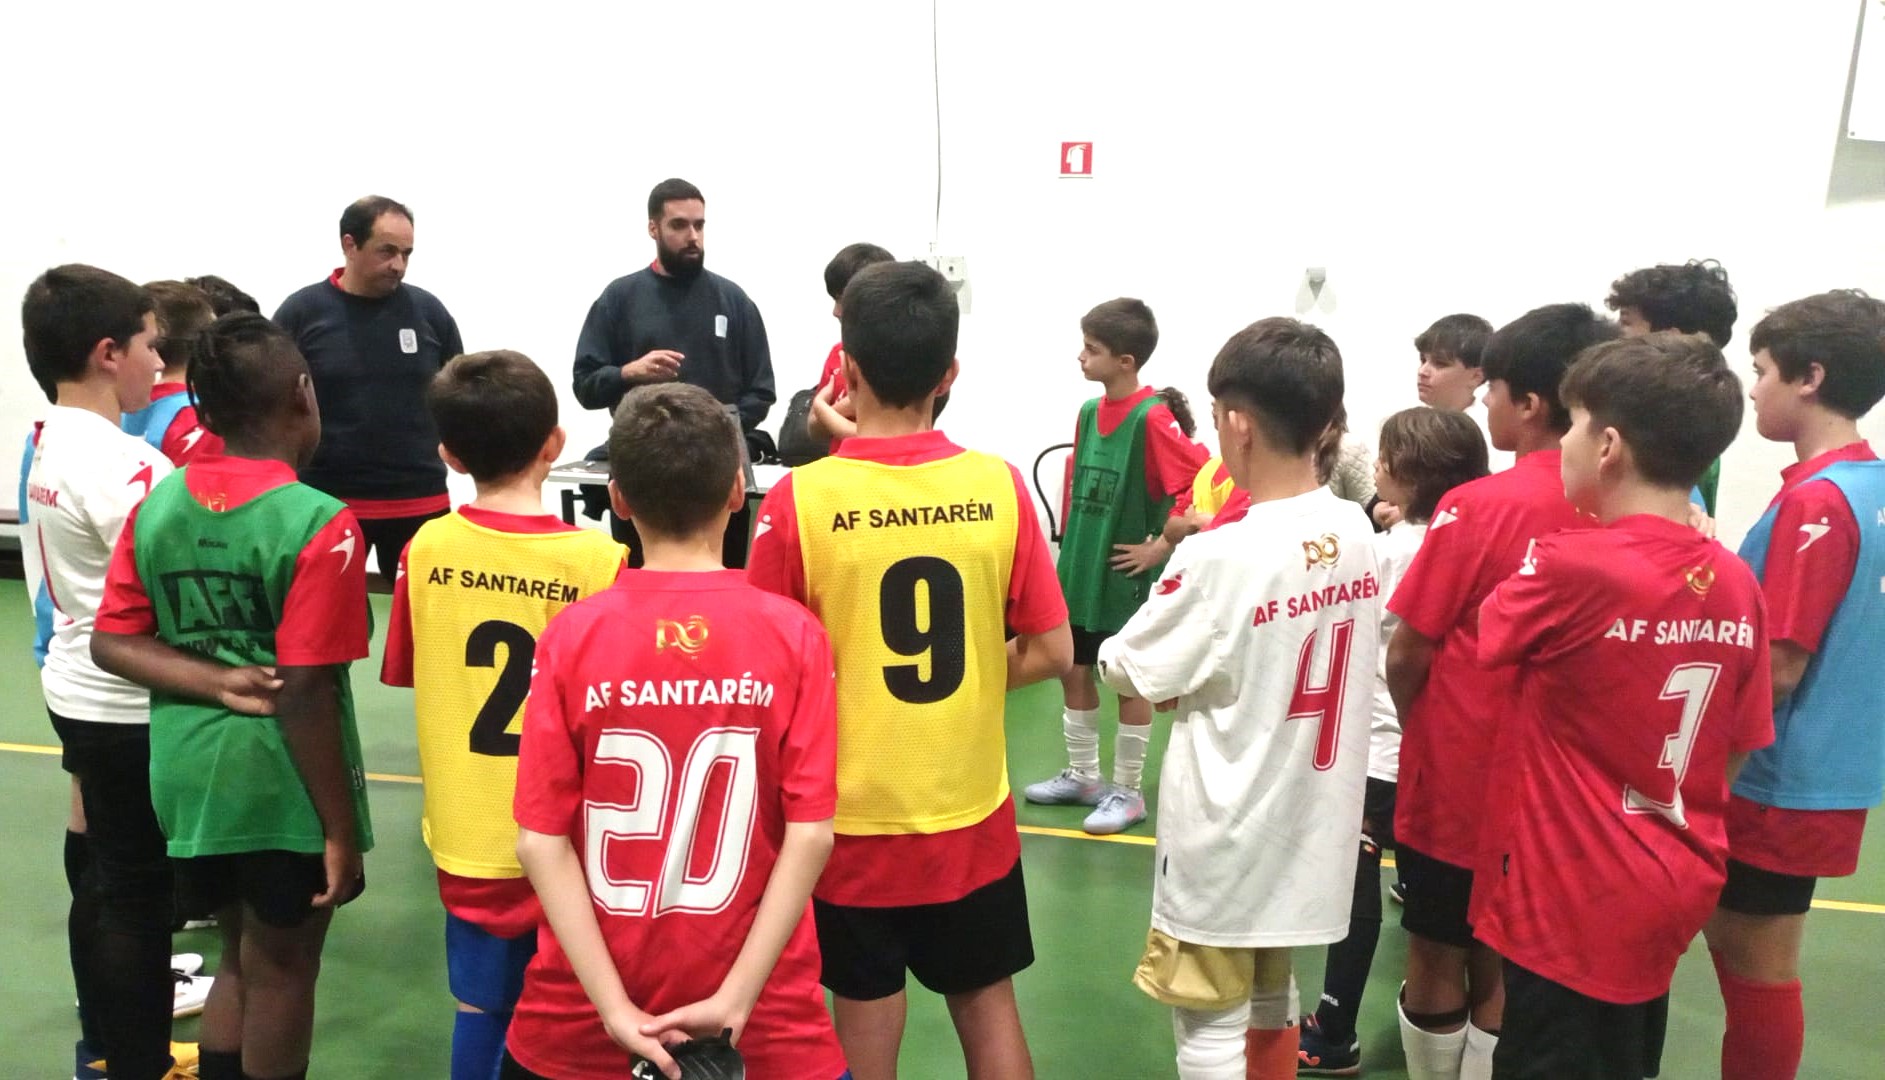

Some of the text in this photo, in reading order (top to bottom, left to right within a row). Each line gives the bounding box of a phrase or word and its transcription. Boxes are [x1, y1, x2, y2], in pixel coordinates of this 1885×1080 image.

[832, 498, 994, 532] AF SANTARÉM
[428, 567, 580, 603] AF SANTARÉM
[1253, 600, 1279, 627] AF
[1604, 617, 1648, 642] AF
[880, 556, 966, 704] 9
[465, 620, 536, 757] 2
[585, 671, 774, 712] AF SANTARÉM
[1285, 618, 1355, 772] 4
[1622, 661, 1722, 830] 3
[584, 727, 761, 918] 20
